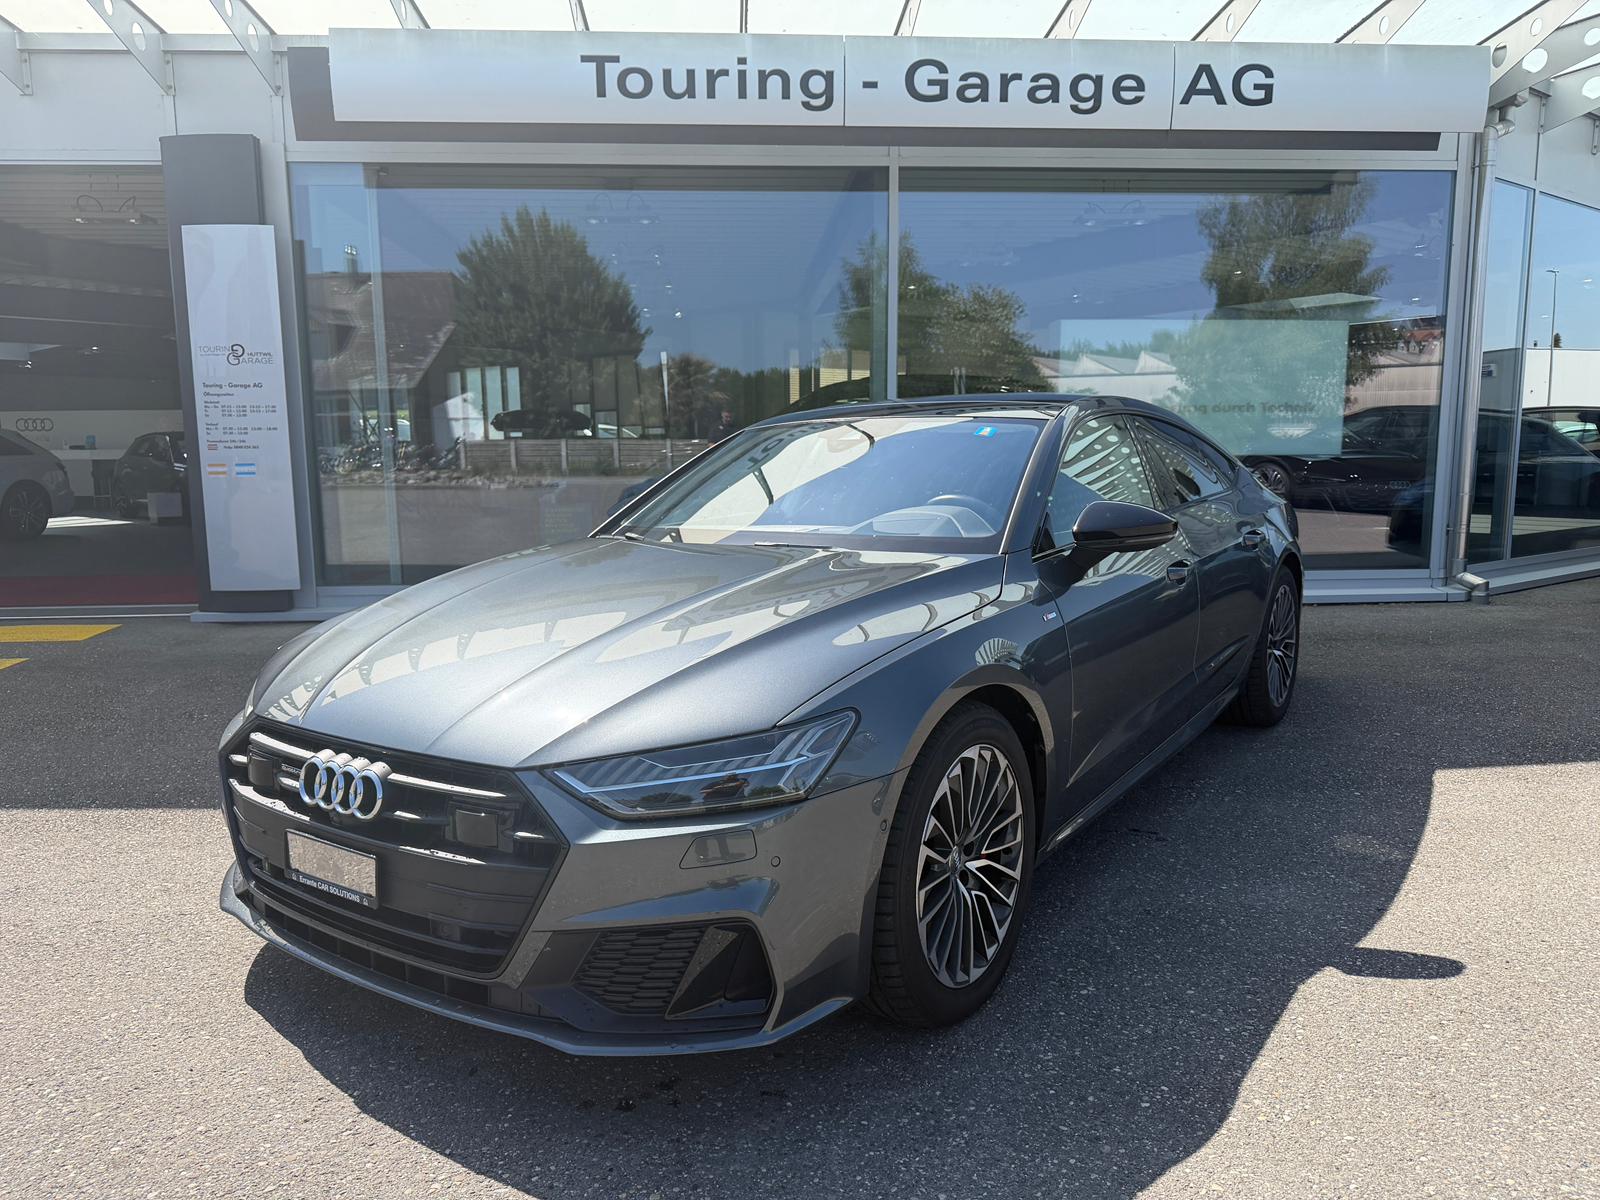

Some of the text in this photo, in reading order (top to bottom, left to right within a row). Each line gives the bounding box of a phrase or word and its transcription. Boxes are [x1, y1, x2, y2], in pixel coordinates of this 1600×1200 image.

[580, 55, 835, 111] Touring
[904, 58, 1146, 115] Garage
[1179, 64, 1275, 106] AG
[1212, 402, 1256, 413] durch
[317, 882, 329, 892] CAR
[330, 885, 361, 903] SOLUTIONS
